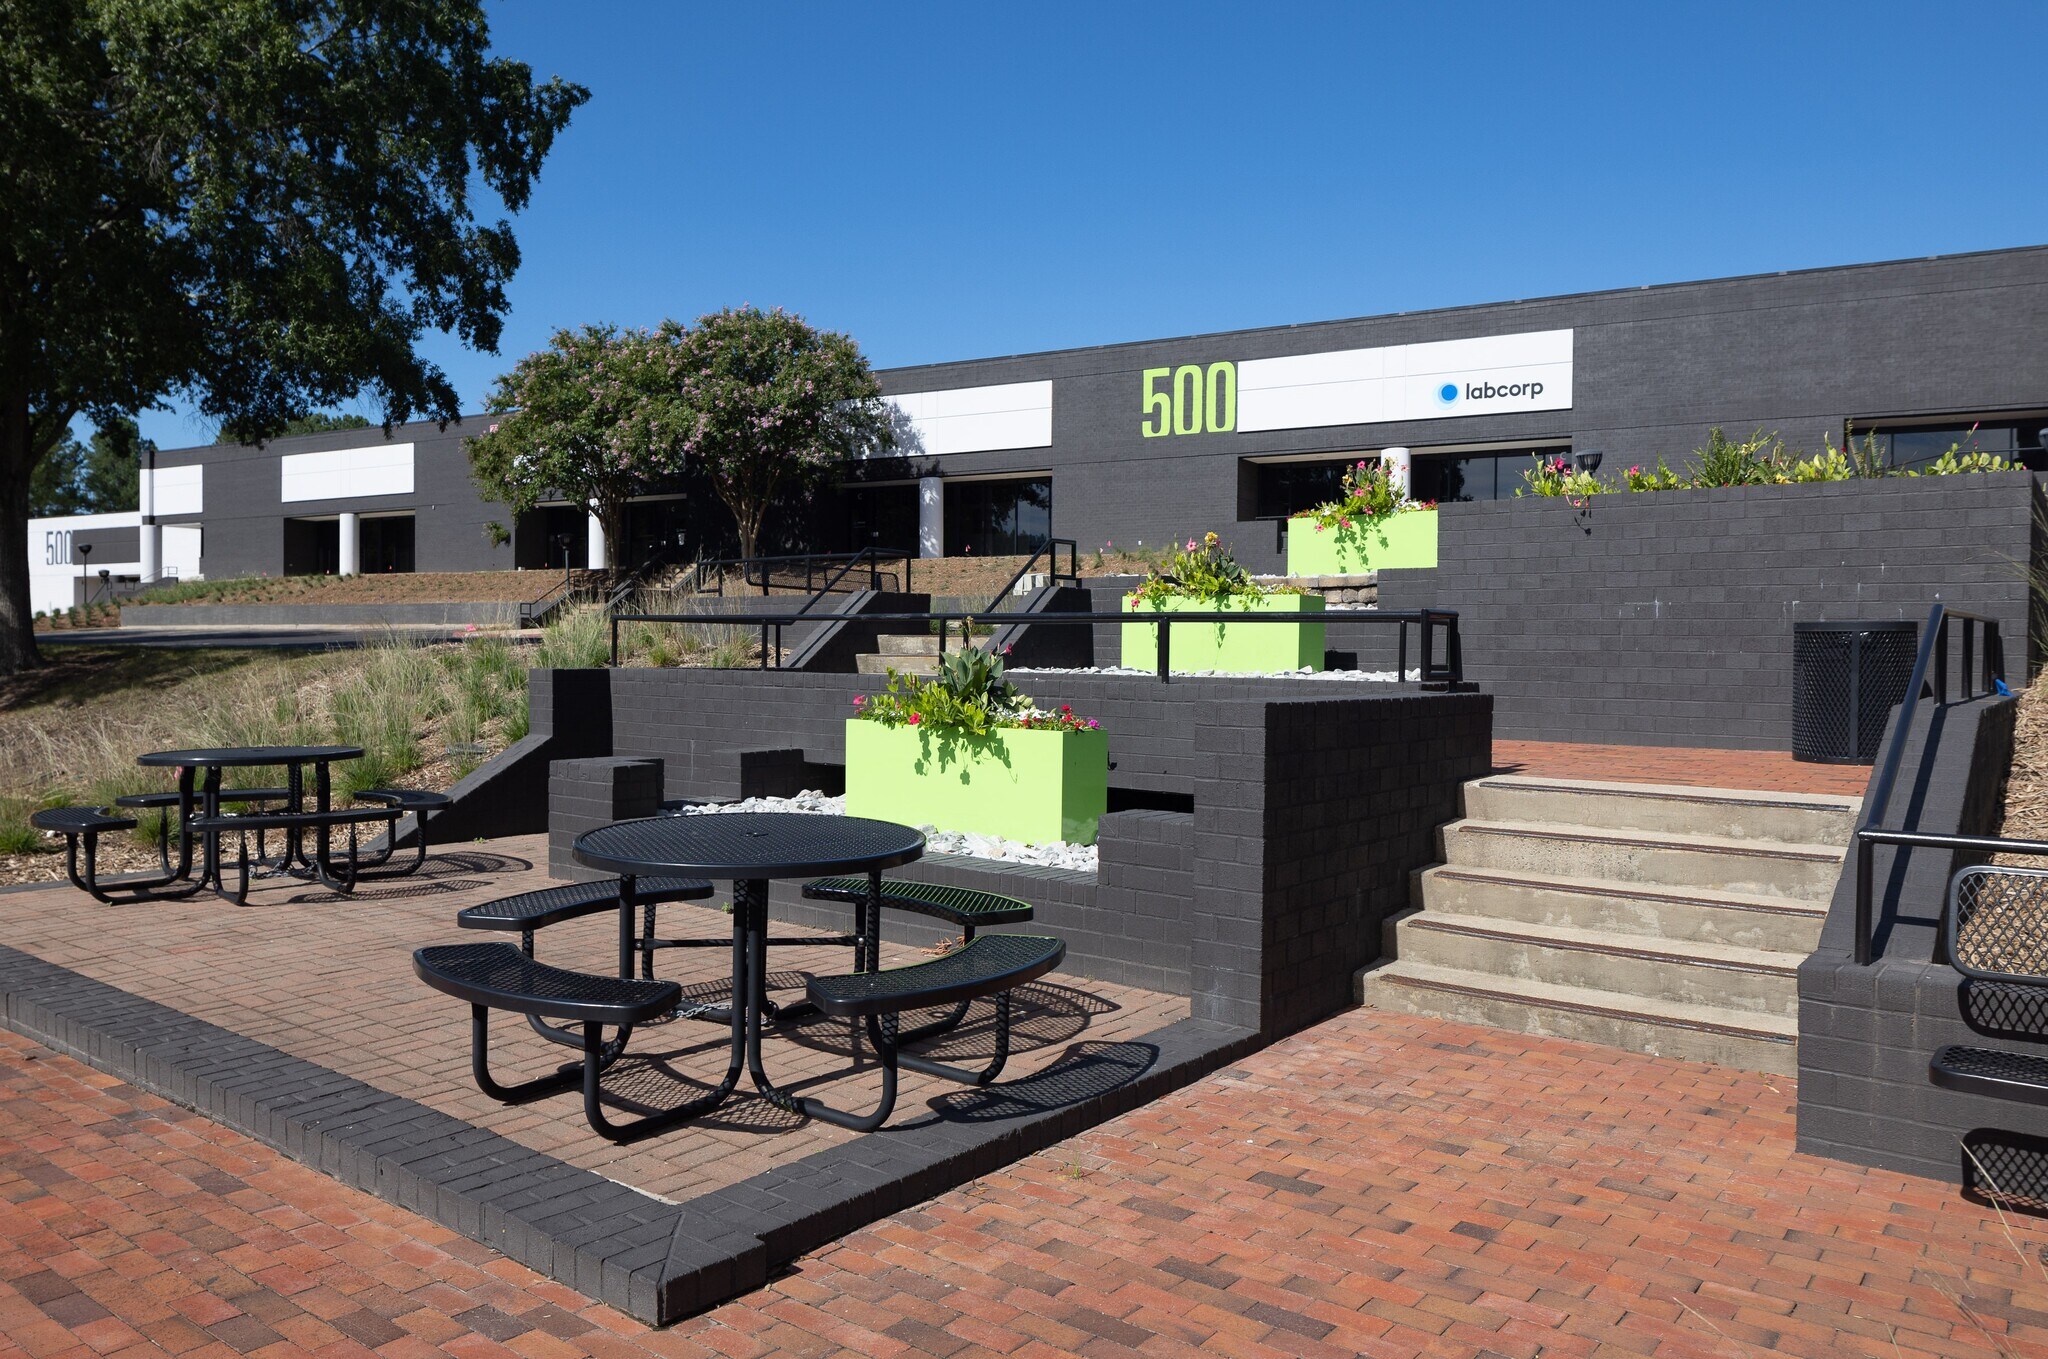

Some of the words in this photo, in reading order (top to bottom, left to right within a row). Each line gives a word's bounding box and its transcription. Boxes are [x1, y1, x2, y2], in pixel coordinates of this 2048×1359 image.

[1142, 361, 1236, 438] 500
[1465, 381, 1544, 400] labcorp
[46, 530, 74, 565] 500
